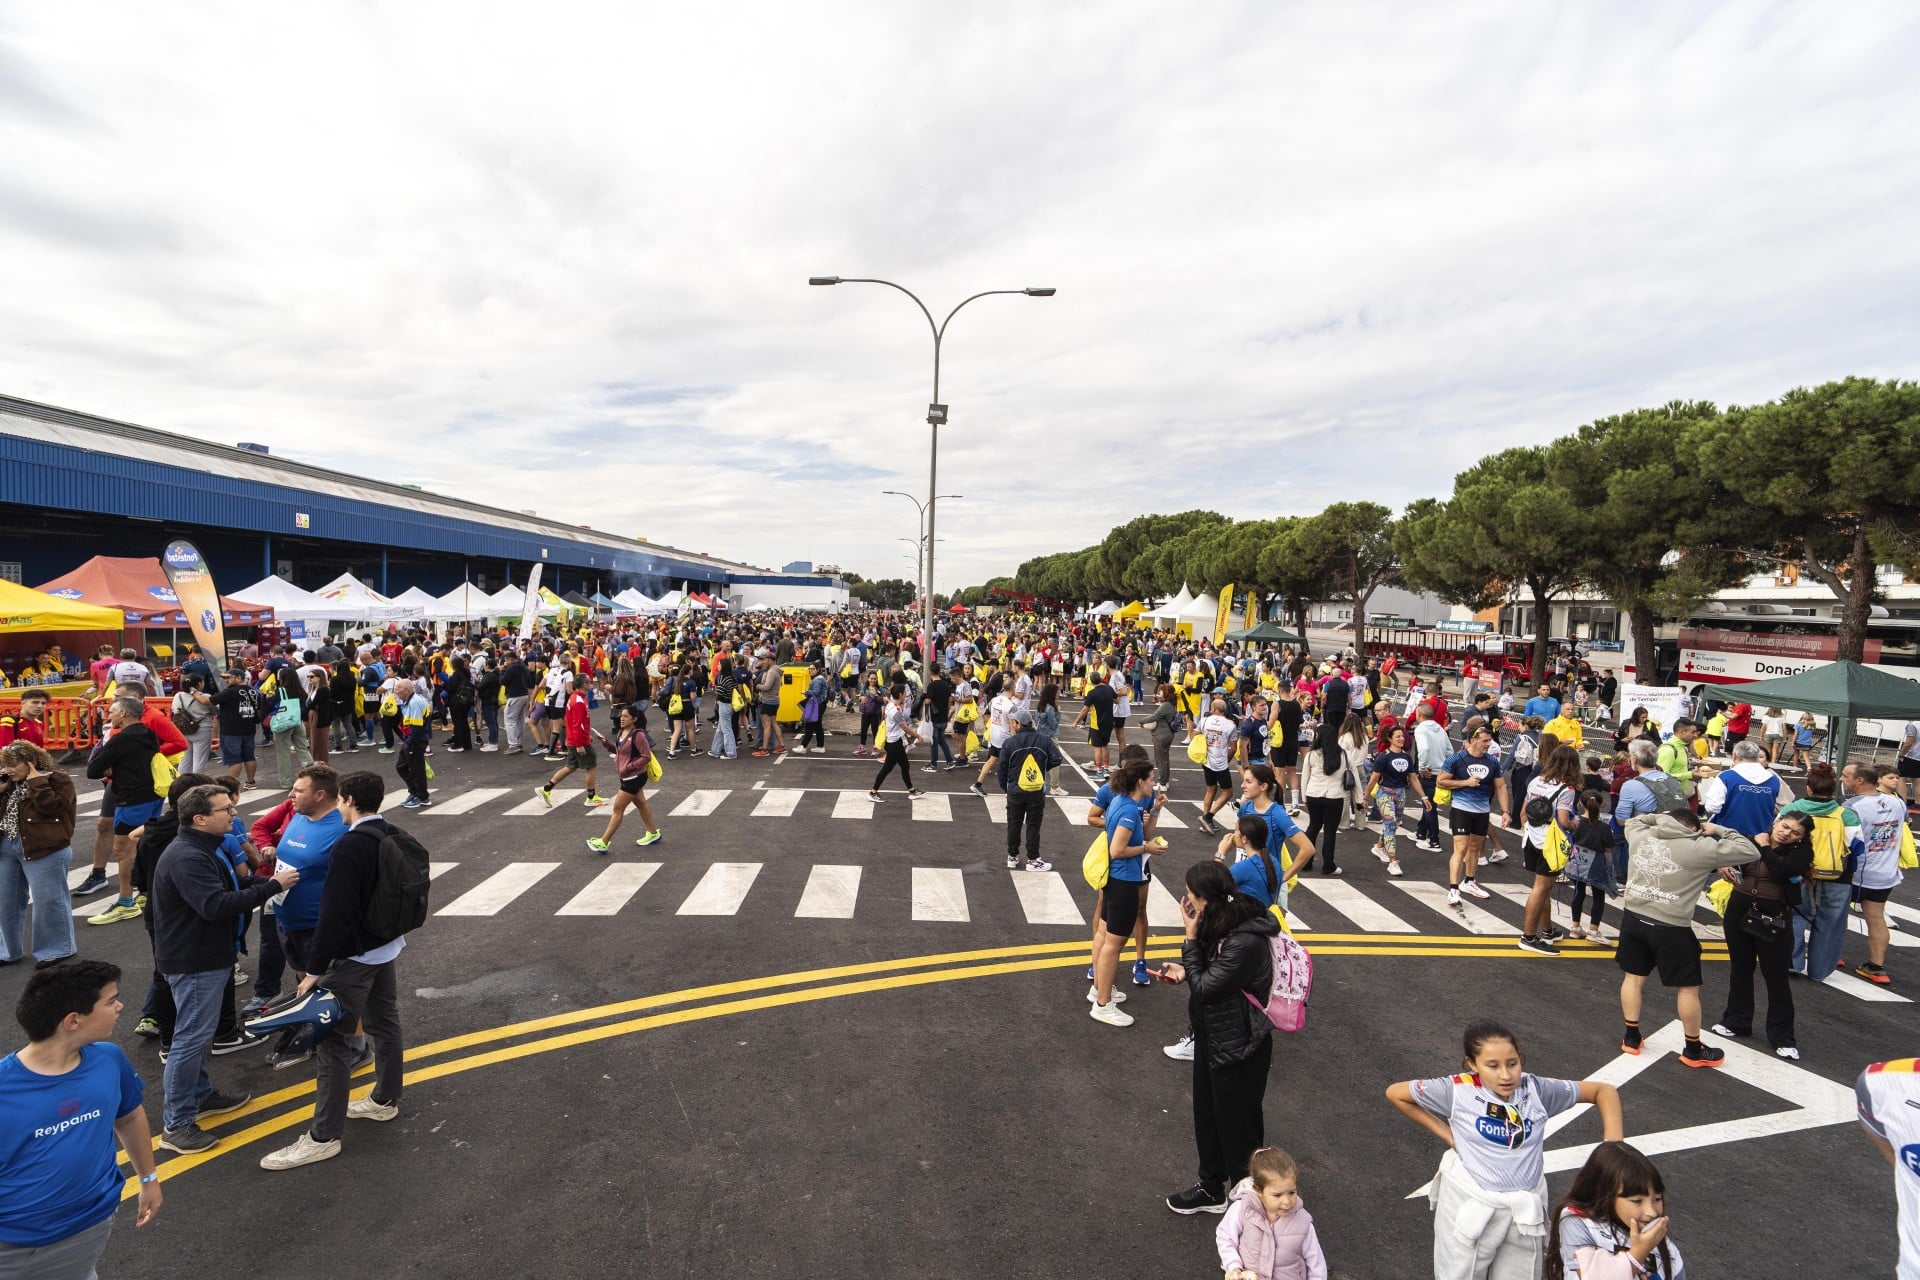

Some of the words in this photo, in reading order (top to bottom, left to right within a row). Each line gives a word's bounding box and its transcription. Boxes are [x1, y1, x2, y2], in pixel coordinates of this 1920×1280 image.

[1696, 664, 1710, 673] Cruz
[1711, 665, 1726, 674] Roja
[1755, 662, 1814, 677] Donaci
[34, 1109, 101, 1138] Reypama
